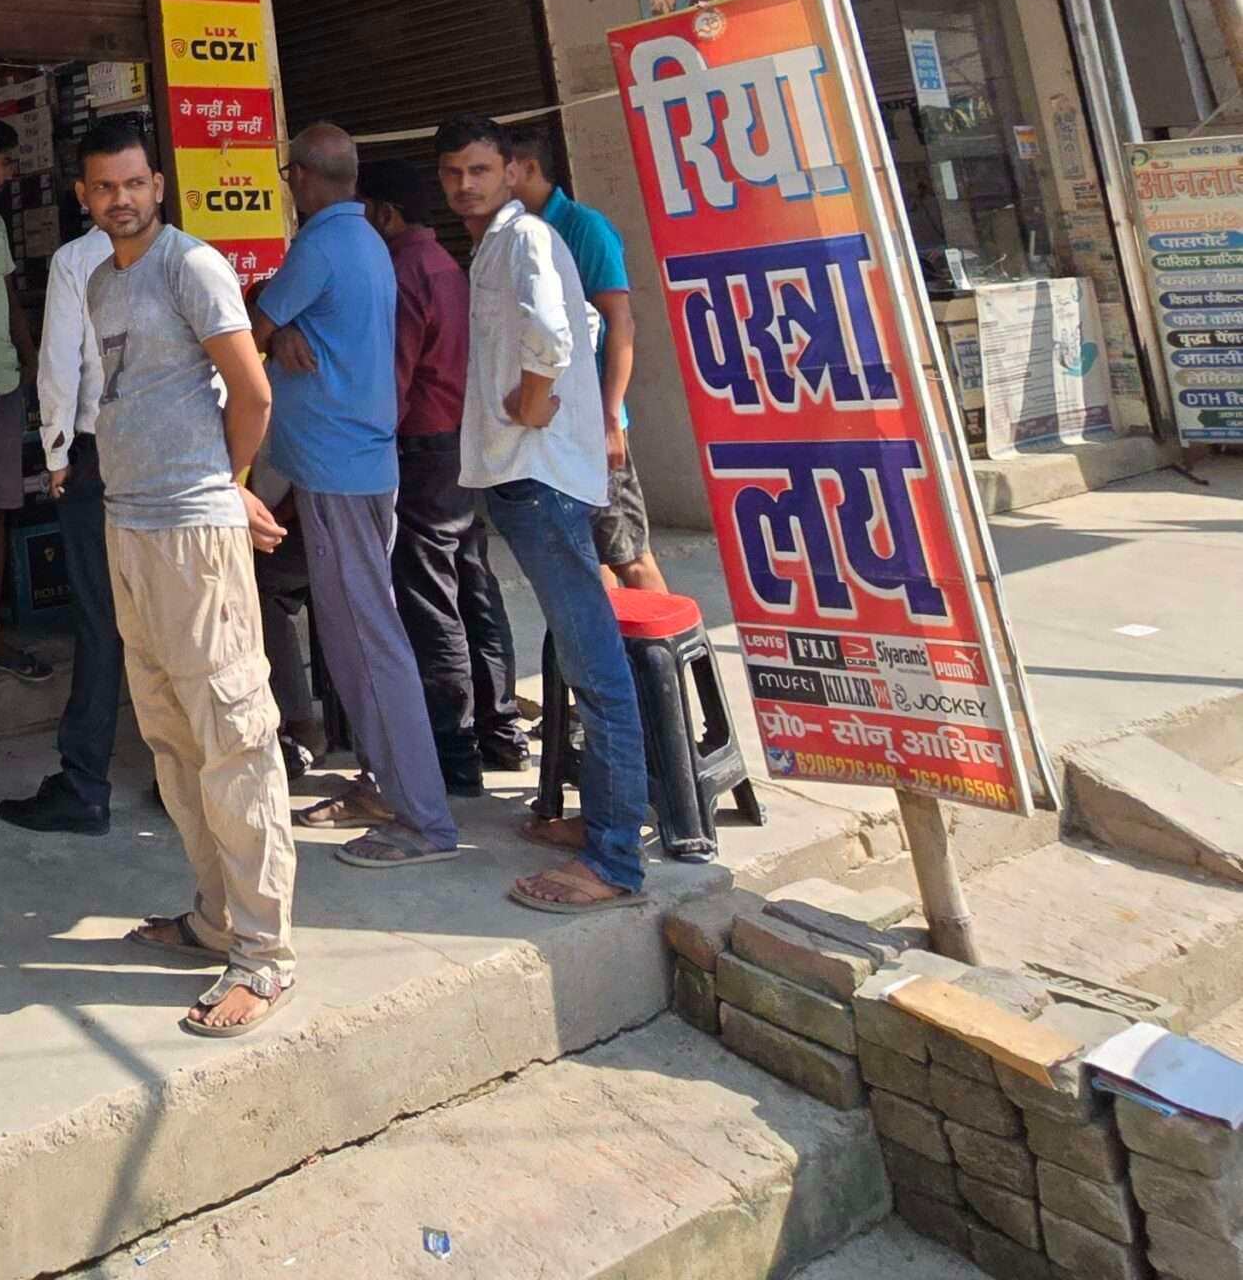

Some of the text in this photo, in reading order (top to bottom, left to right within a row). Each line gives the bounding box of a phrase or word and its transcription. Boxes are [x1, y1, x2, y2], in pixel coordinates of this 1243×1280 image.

[204, 27, 237, 38] LUX
[191, 40, 256, 62] COZI
[180, 99, 241, 118] ये नहीं तो
[207, 116, 263, 137] कुछ नहीं
[629, 35, 849, 218] रिया
[219, 176, 252, 186] LUX
[206, 190, 271, 211] COZI
[1186, 393, 1221, 406] DTH
[707, 438, 952, 624] लय
[822, 674, 876, 707] KILLER
[913, 694, 988, 716] JOCKEY
[829, 713, 905, 764] सोनू
